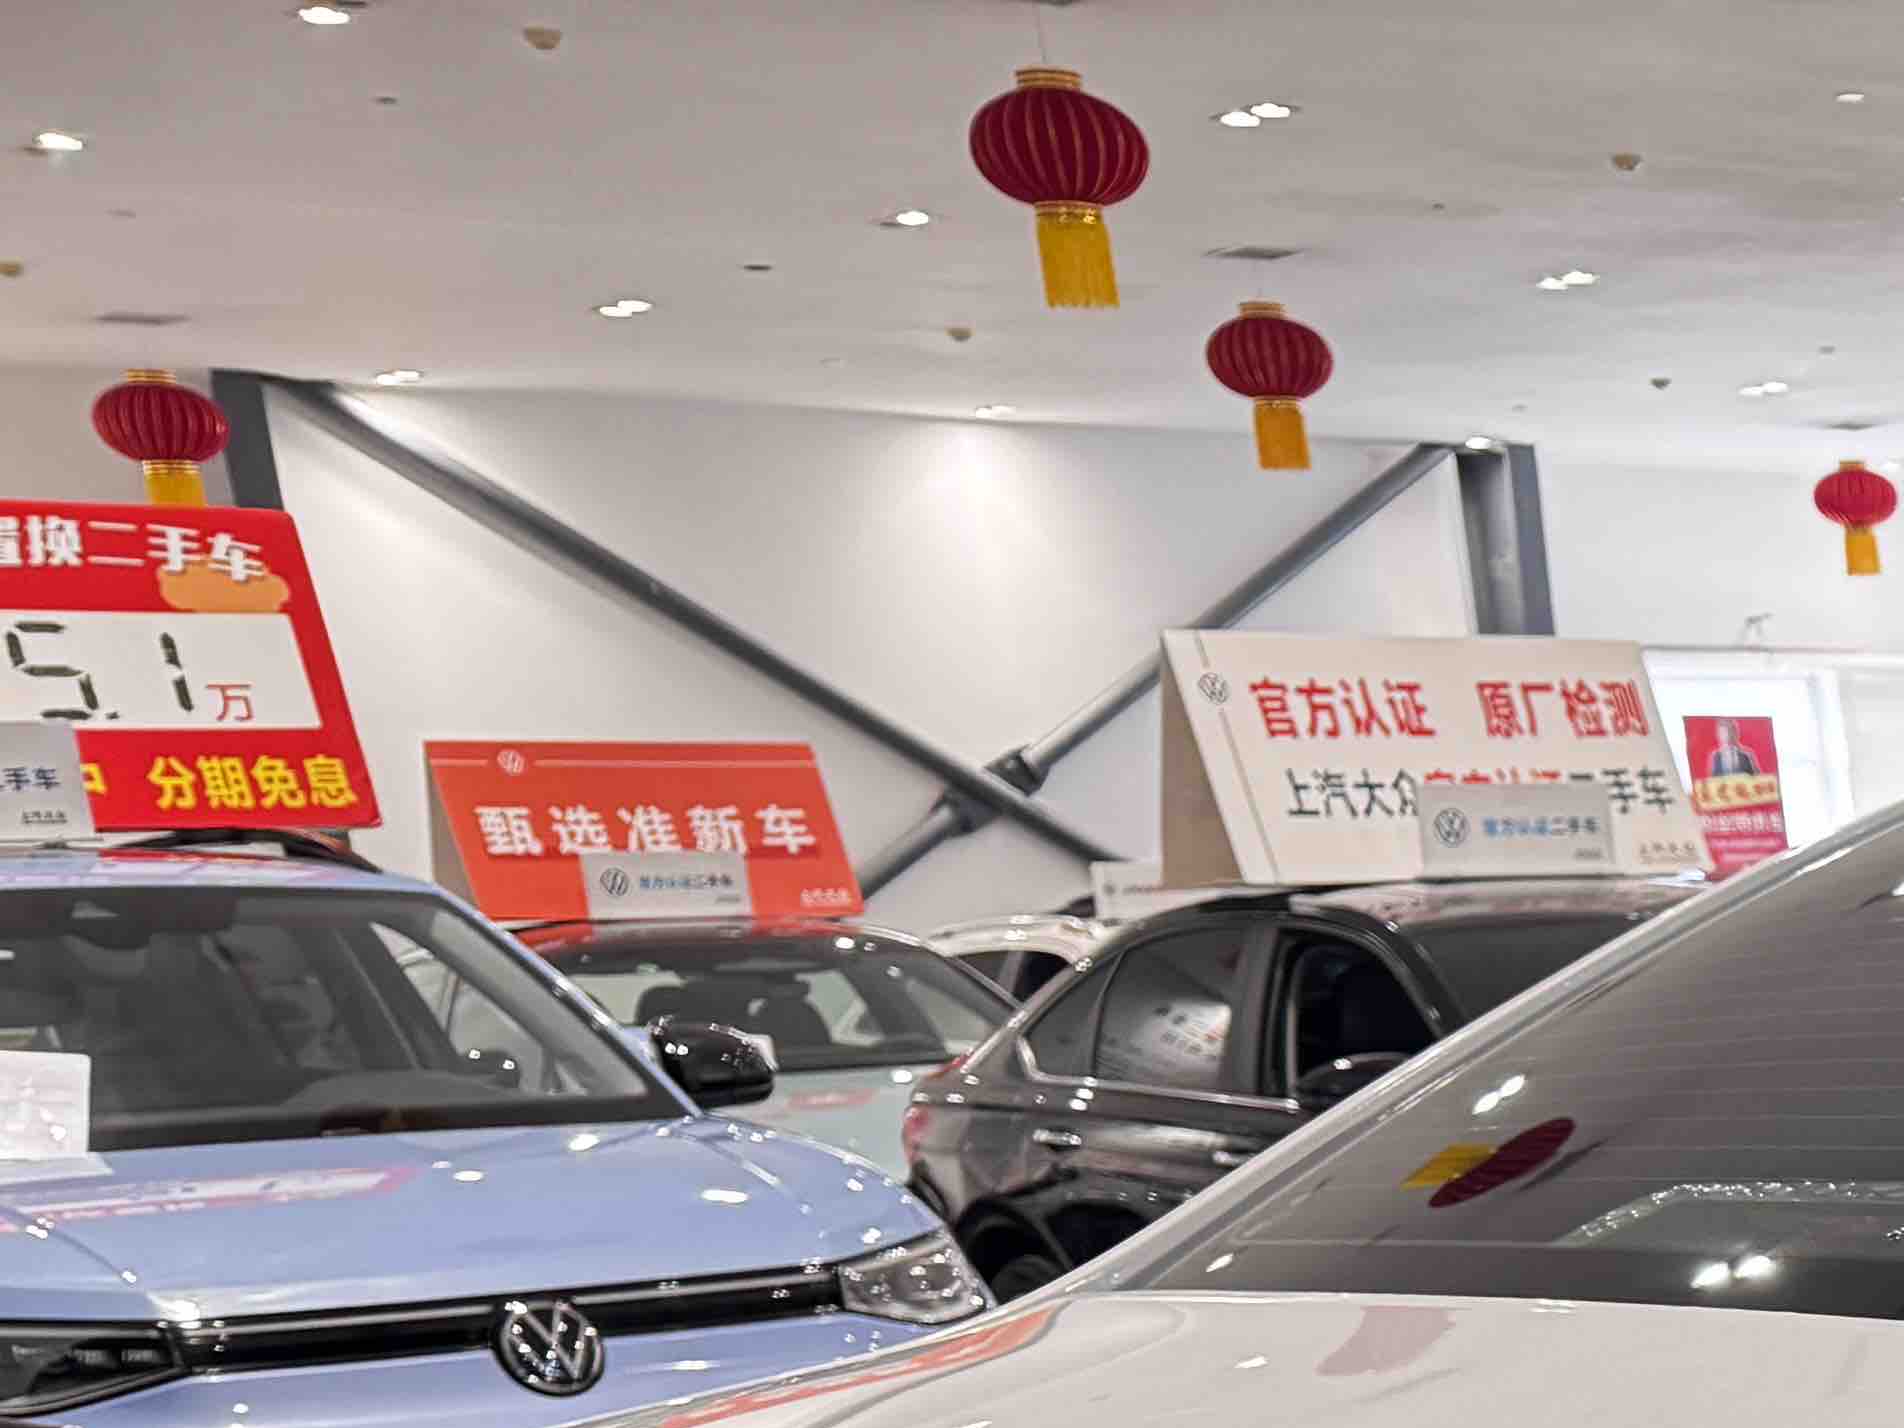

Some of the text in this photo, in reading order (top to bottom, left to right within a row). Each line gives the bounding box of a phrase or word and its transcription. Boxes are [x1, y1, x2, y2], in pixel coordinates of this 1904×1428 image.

[1250, 676, 1650, 738] 官方认证 原厂检测
[148, 755, 358, 809] 分期免息
[475, 804, 816, 855] 甄选准新车
